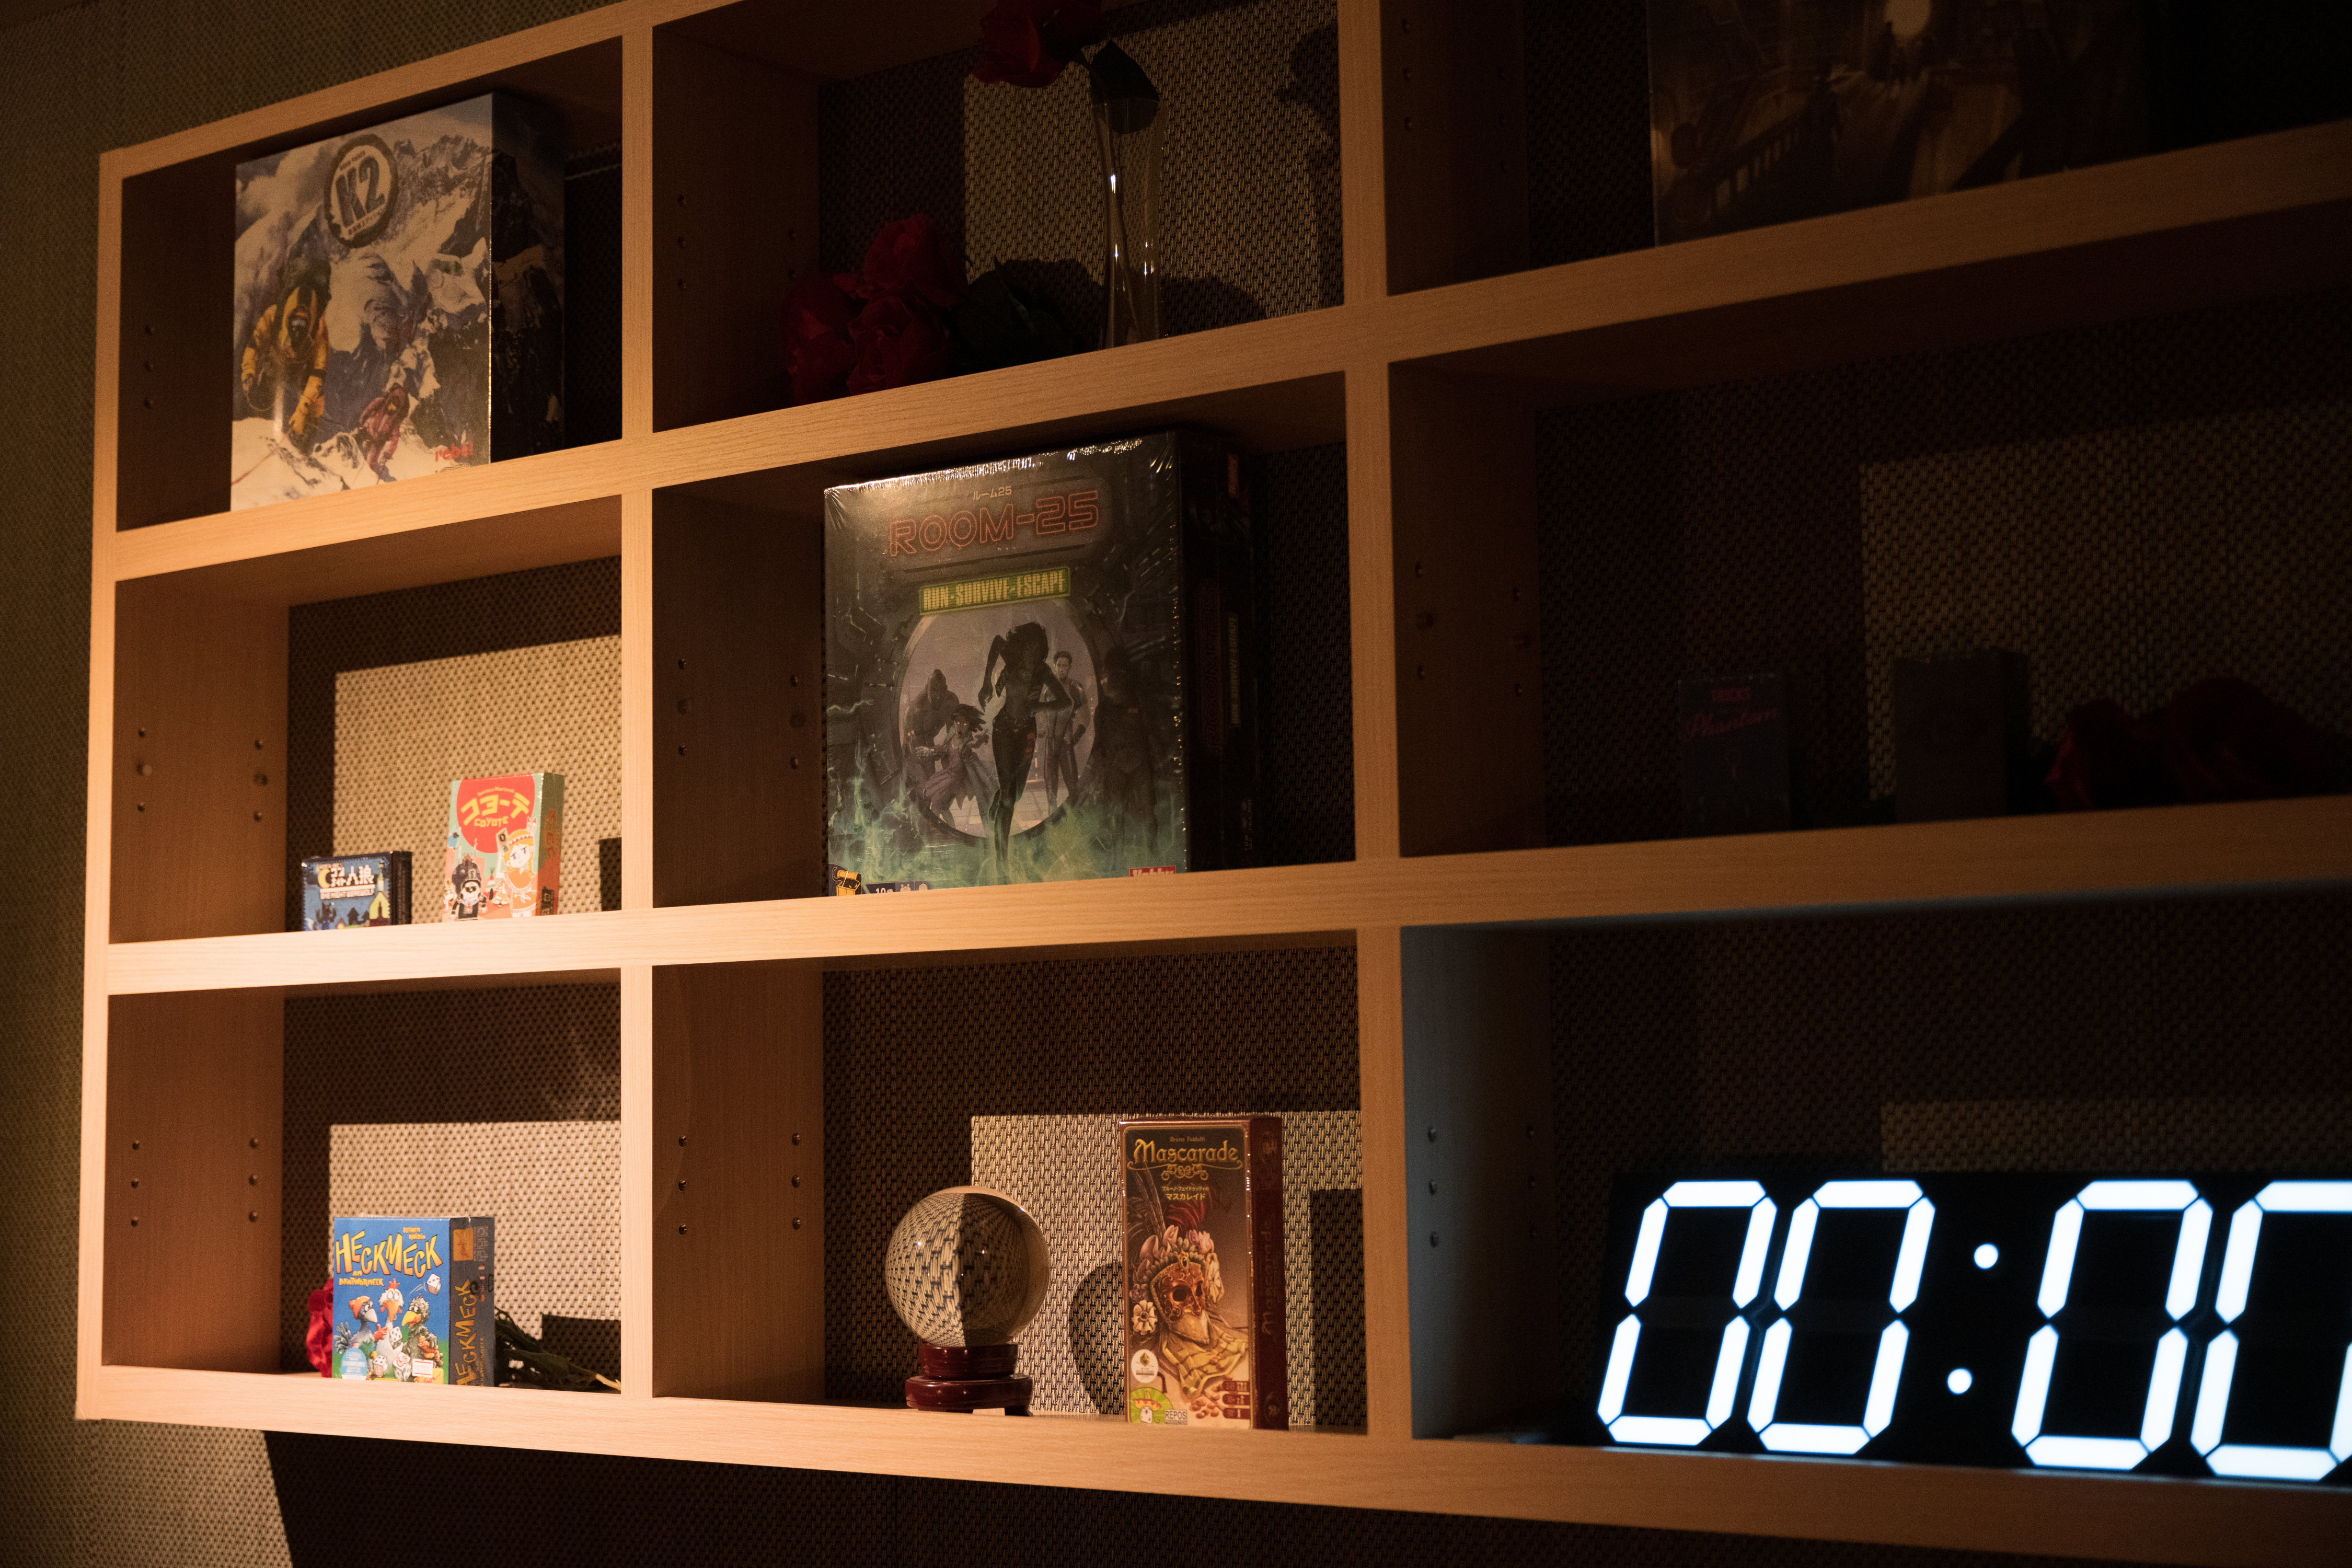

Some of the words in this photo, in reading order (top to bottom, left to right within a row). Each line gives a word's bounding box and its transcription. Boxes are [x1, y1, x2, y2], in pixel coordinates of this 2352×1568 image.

[335, 156, 386, 228] K2
[435, 441, 473, 462] rebel
[973, 486, 1012, 501] ルーム25
[890, 490, 1099, 557] ROOM-25
[460, 792, 530, 826] コヨーテ
[474, 816, 509, 827] COYOTE
[1133, 1138, 1238, 1163] Mascarade
[335, 1229, 444, 1278] HECKMECK
[1597, 1179, 2352, 1481] 00:00
[1165, 1410, 1186, 1420] REPOS
